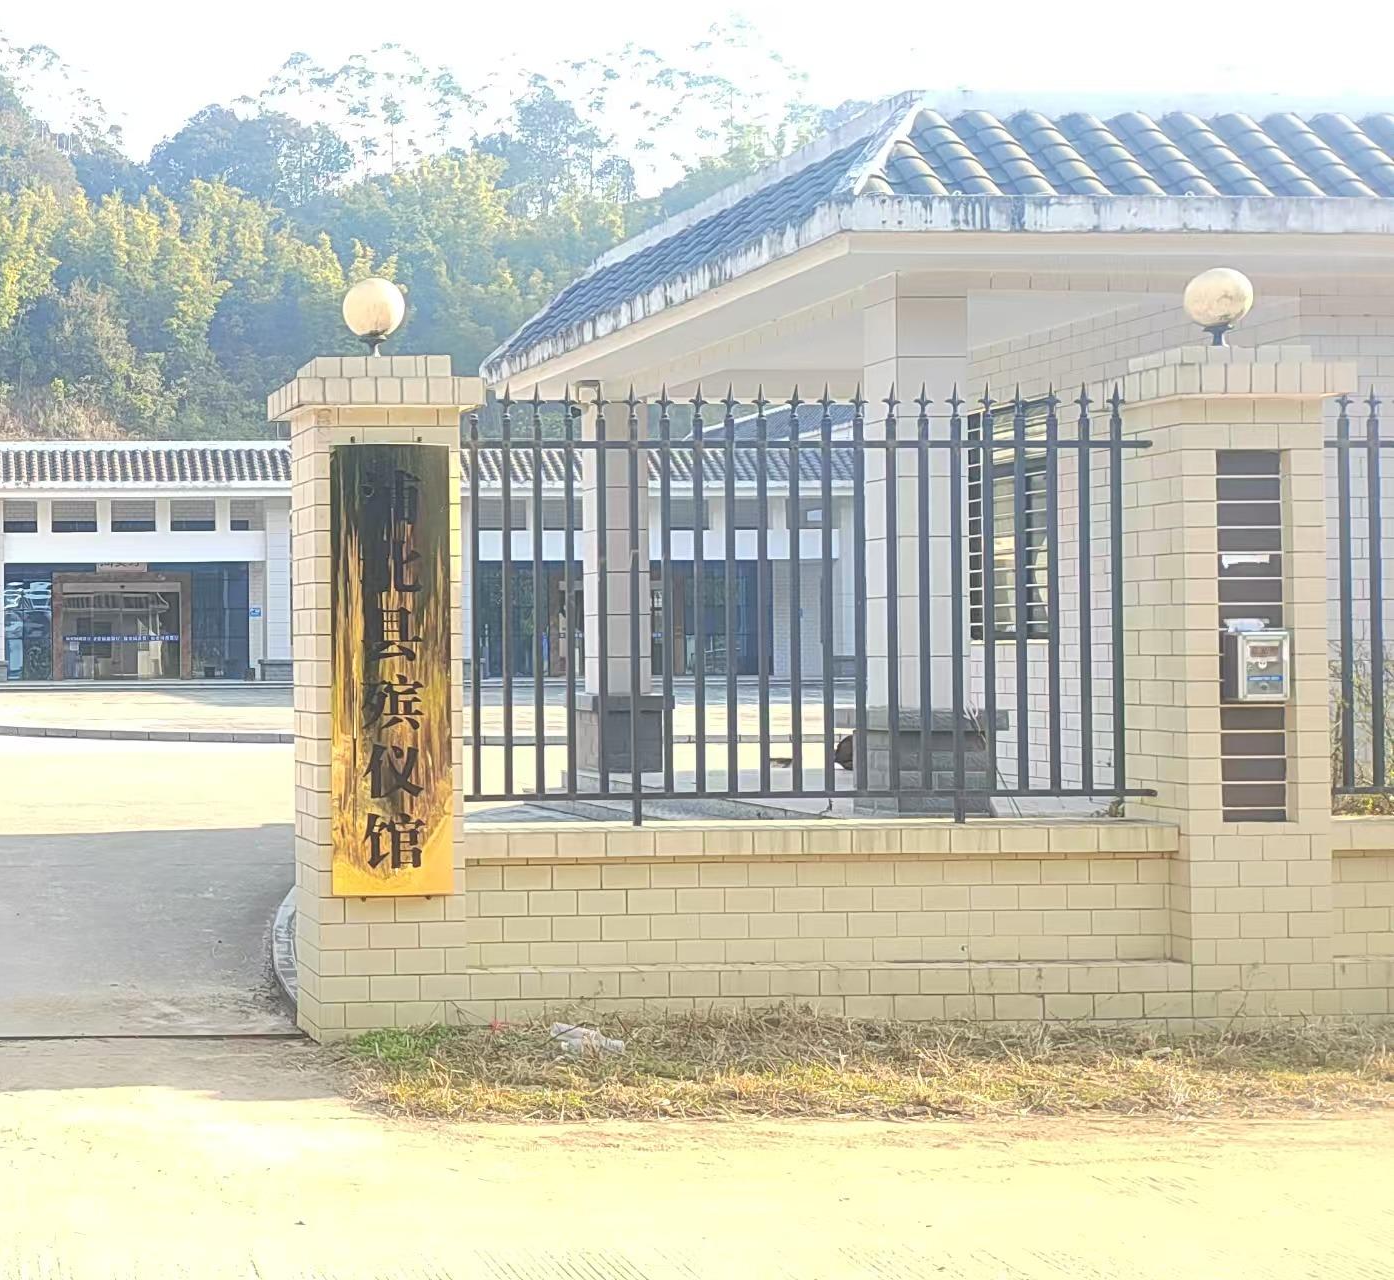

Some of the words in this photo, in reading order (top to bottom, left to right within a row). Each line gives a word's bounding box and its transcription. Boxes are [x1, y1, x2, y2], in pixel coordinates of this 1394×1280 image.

[361, 468, 426, 870] 浦北县殡仪馆
